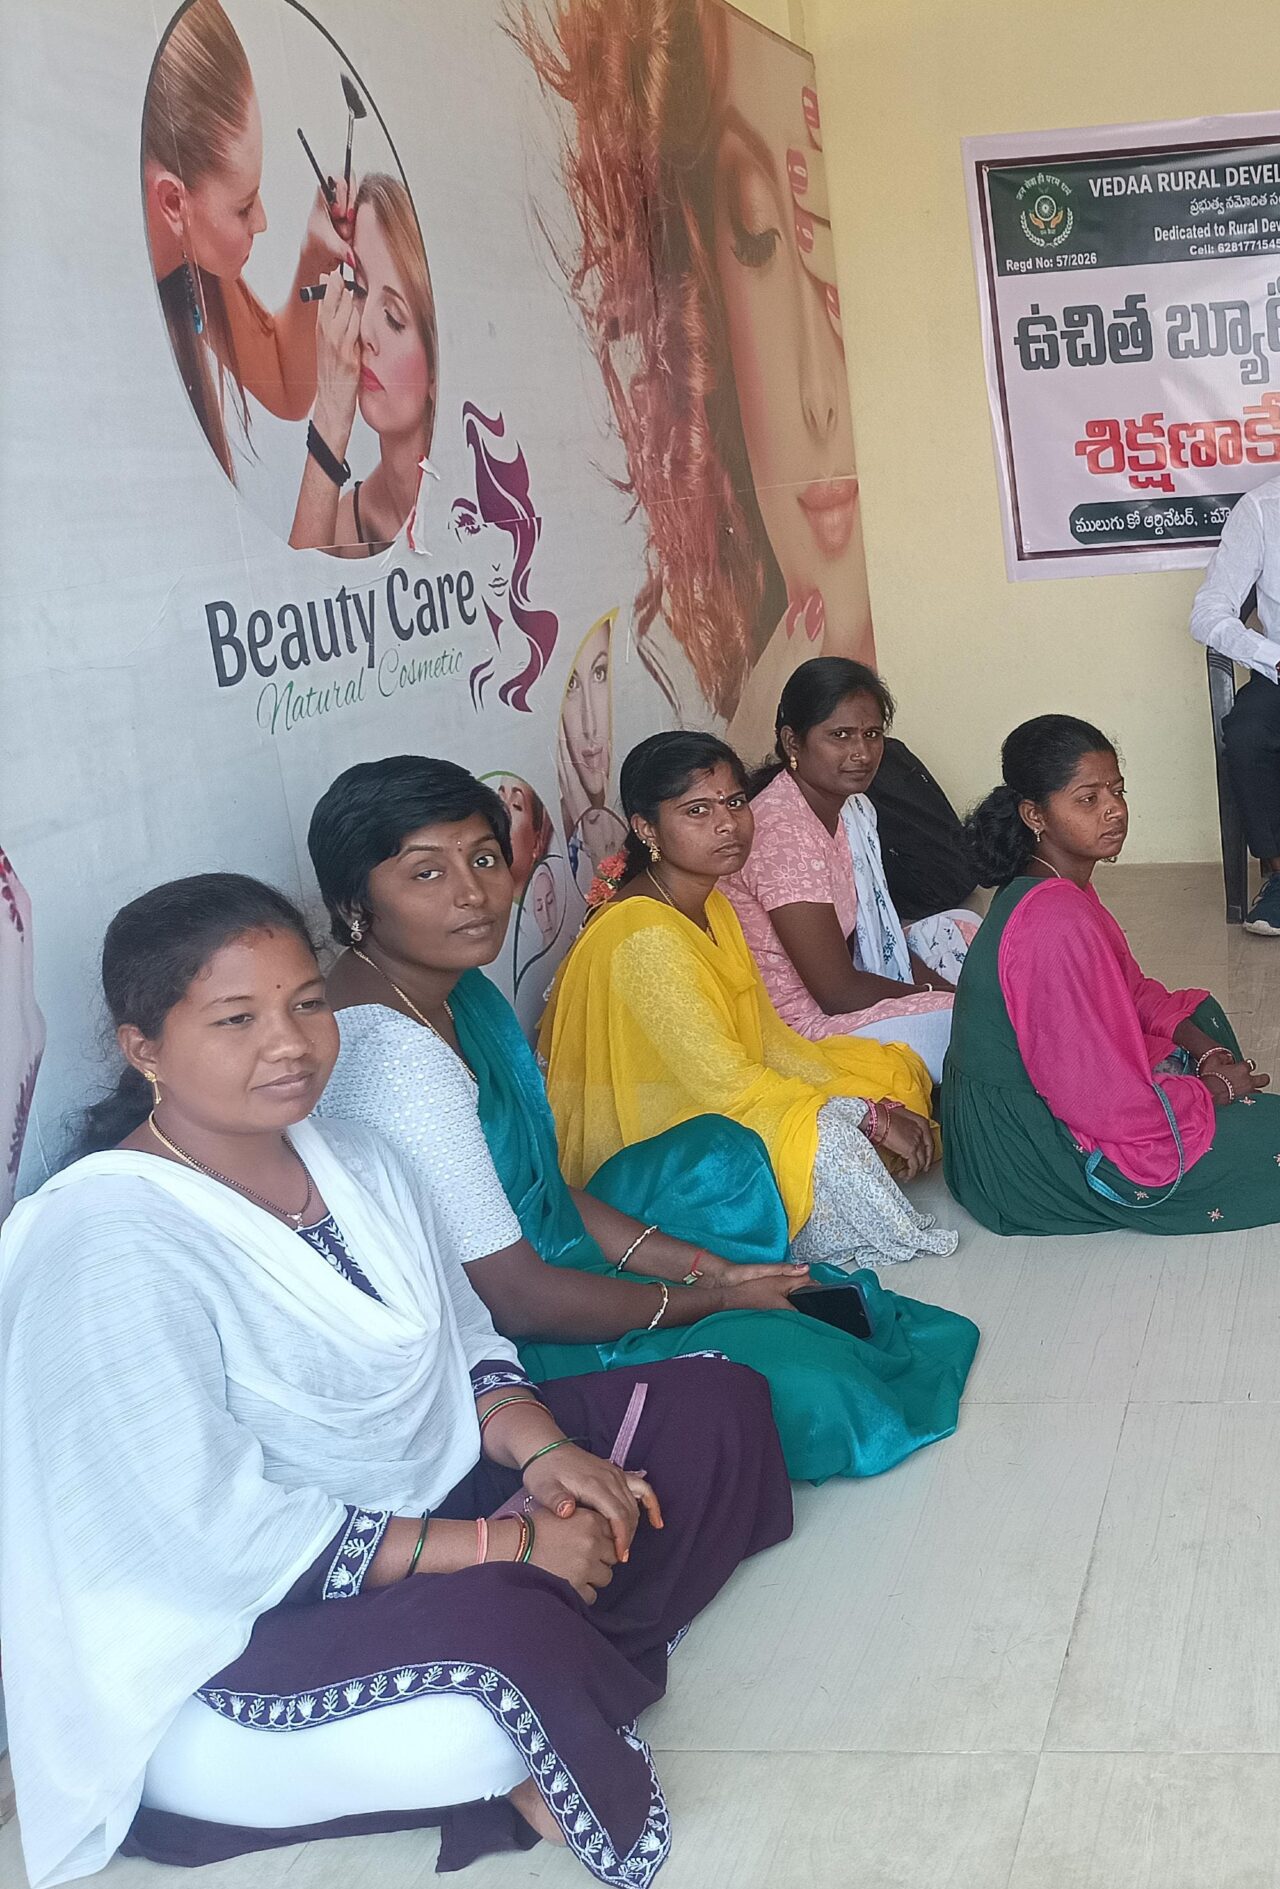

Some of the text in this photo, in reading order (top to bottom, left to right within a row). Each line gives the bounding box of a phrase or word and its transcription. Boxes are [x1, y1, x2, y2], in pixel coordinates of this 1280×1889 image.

[1088, 174, 1152, 198] VEDAA
[1157, 169, 1221, 193] RURAL
[1189, 197, 1225, 216] ప్రభుత్వ
[1154, 222, 1211, 242] Dedicated
[1214, 222, 1225, 236] to
[1228, 218, 1258, 236] Rural
[1006, 252, 1097, 272] Regd No: 57/2026
[1189, 244, 1214, 256] Cell:
[1013, 293, 1154, 371] ఉచిత
[1075, 516, 1125, 533] ములుగు
[205, 567, 477, 688] Beauty Care
[256, 645, 464, 736] Natural Cosmetic
